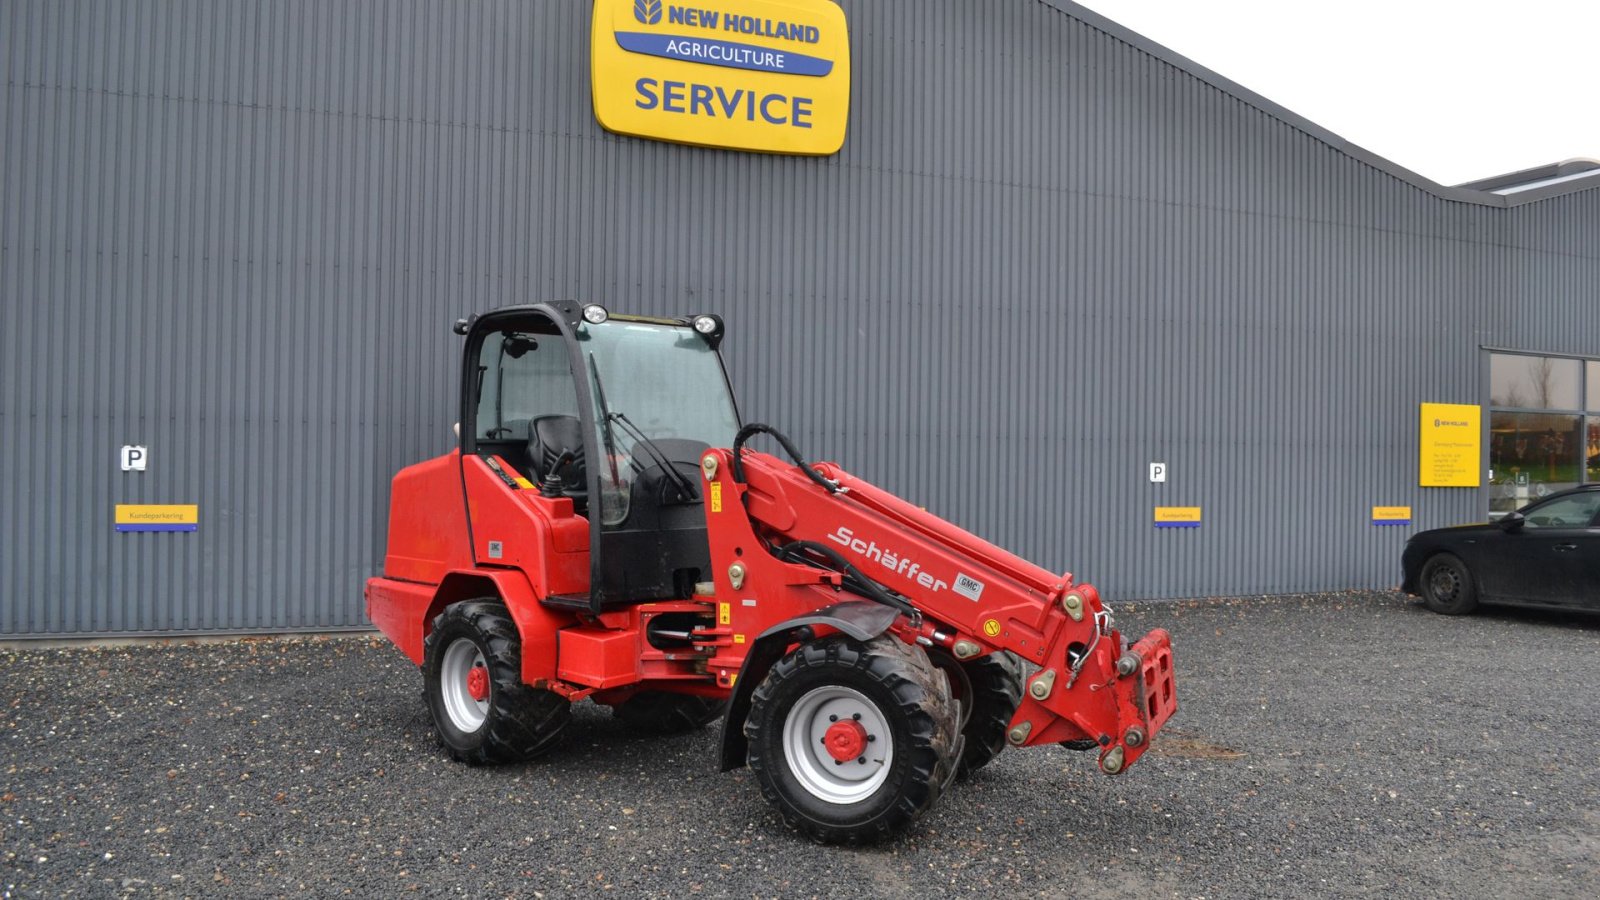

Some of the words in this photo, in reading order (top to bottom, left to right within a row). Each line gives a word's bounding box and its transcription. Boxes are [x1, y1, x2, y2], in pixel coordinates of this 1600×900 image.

[668, 5, 719, 29] NEW
[724, 14, 820, 44] HOLLAND
[666, 40, 785, 68] AGRICULTURE
[635, 77, 813, 128] SERVICE
[128, 449, 142, 466] P
[1154, 466, 1162, 479] P
[129, 512, 184, 520] Kundeparkering
[827, 526, 948, 592] Schäffer
[960, 577, 978, 592] GMC
